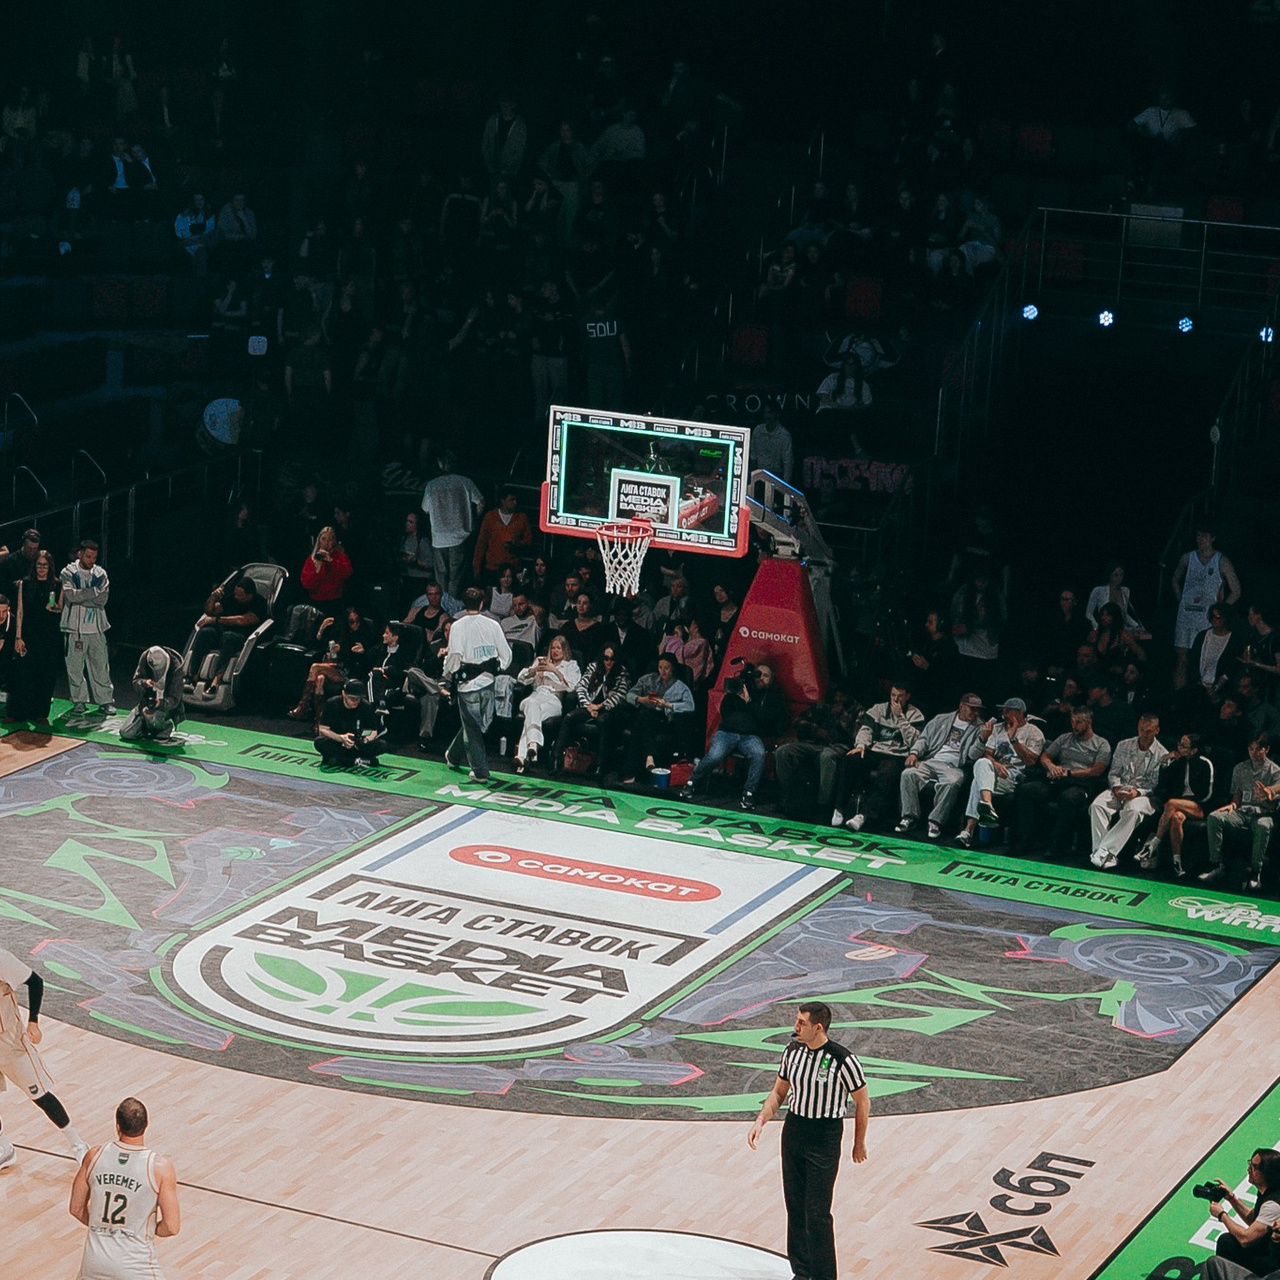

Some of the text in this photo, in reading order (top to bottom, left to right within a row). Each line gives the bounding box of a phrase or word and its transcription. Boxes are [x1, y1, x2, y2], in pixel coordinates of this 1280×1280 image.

[620, 483, 667, 497] ЛИГА СТАВОК
[620, 494, 666, 506] MEDIA
[751, 630, 800, 644] самокат
[252, 749, 310, 767] ЛИГА
[434, 783, 908, 873] MEDIA BASKET
[458, 778, 908, 859] ЛИГА СТАВОК
[516, 856, 701, 898] самокат
[958, 866, 1127, 905] ЛИГА СТАВОК
[338, 887, 668, 961] ЛИГА СТАВОК
[234, 922, 628, 1005] BASKET
[261, 906, 630, 995] MEDIA
[95, 1172, 143, 1194] VEREMEY
[101, 1190, 129, 1226] 12
